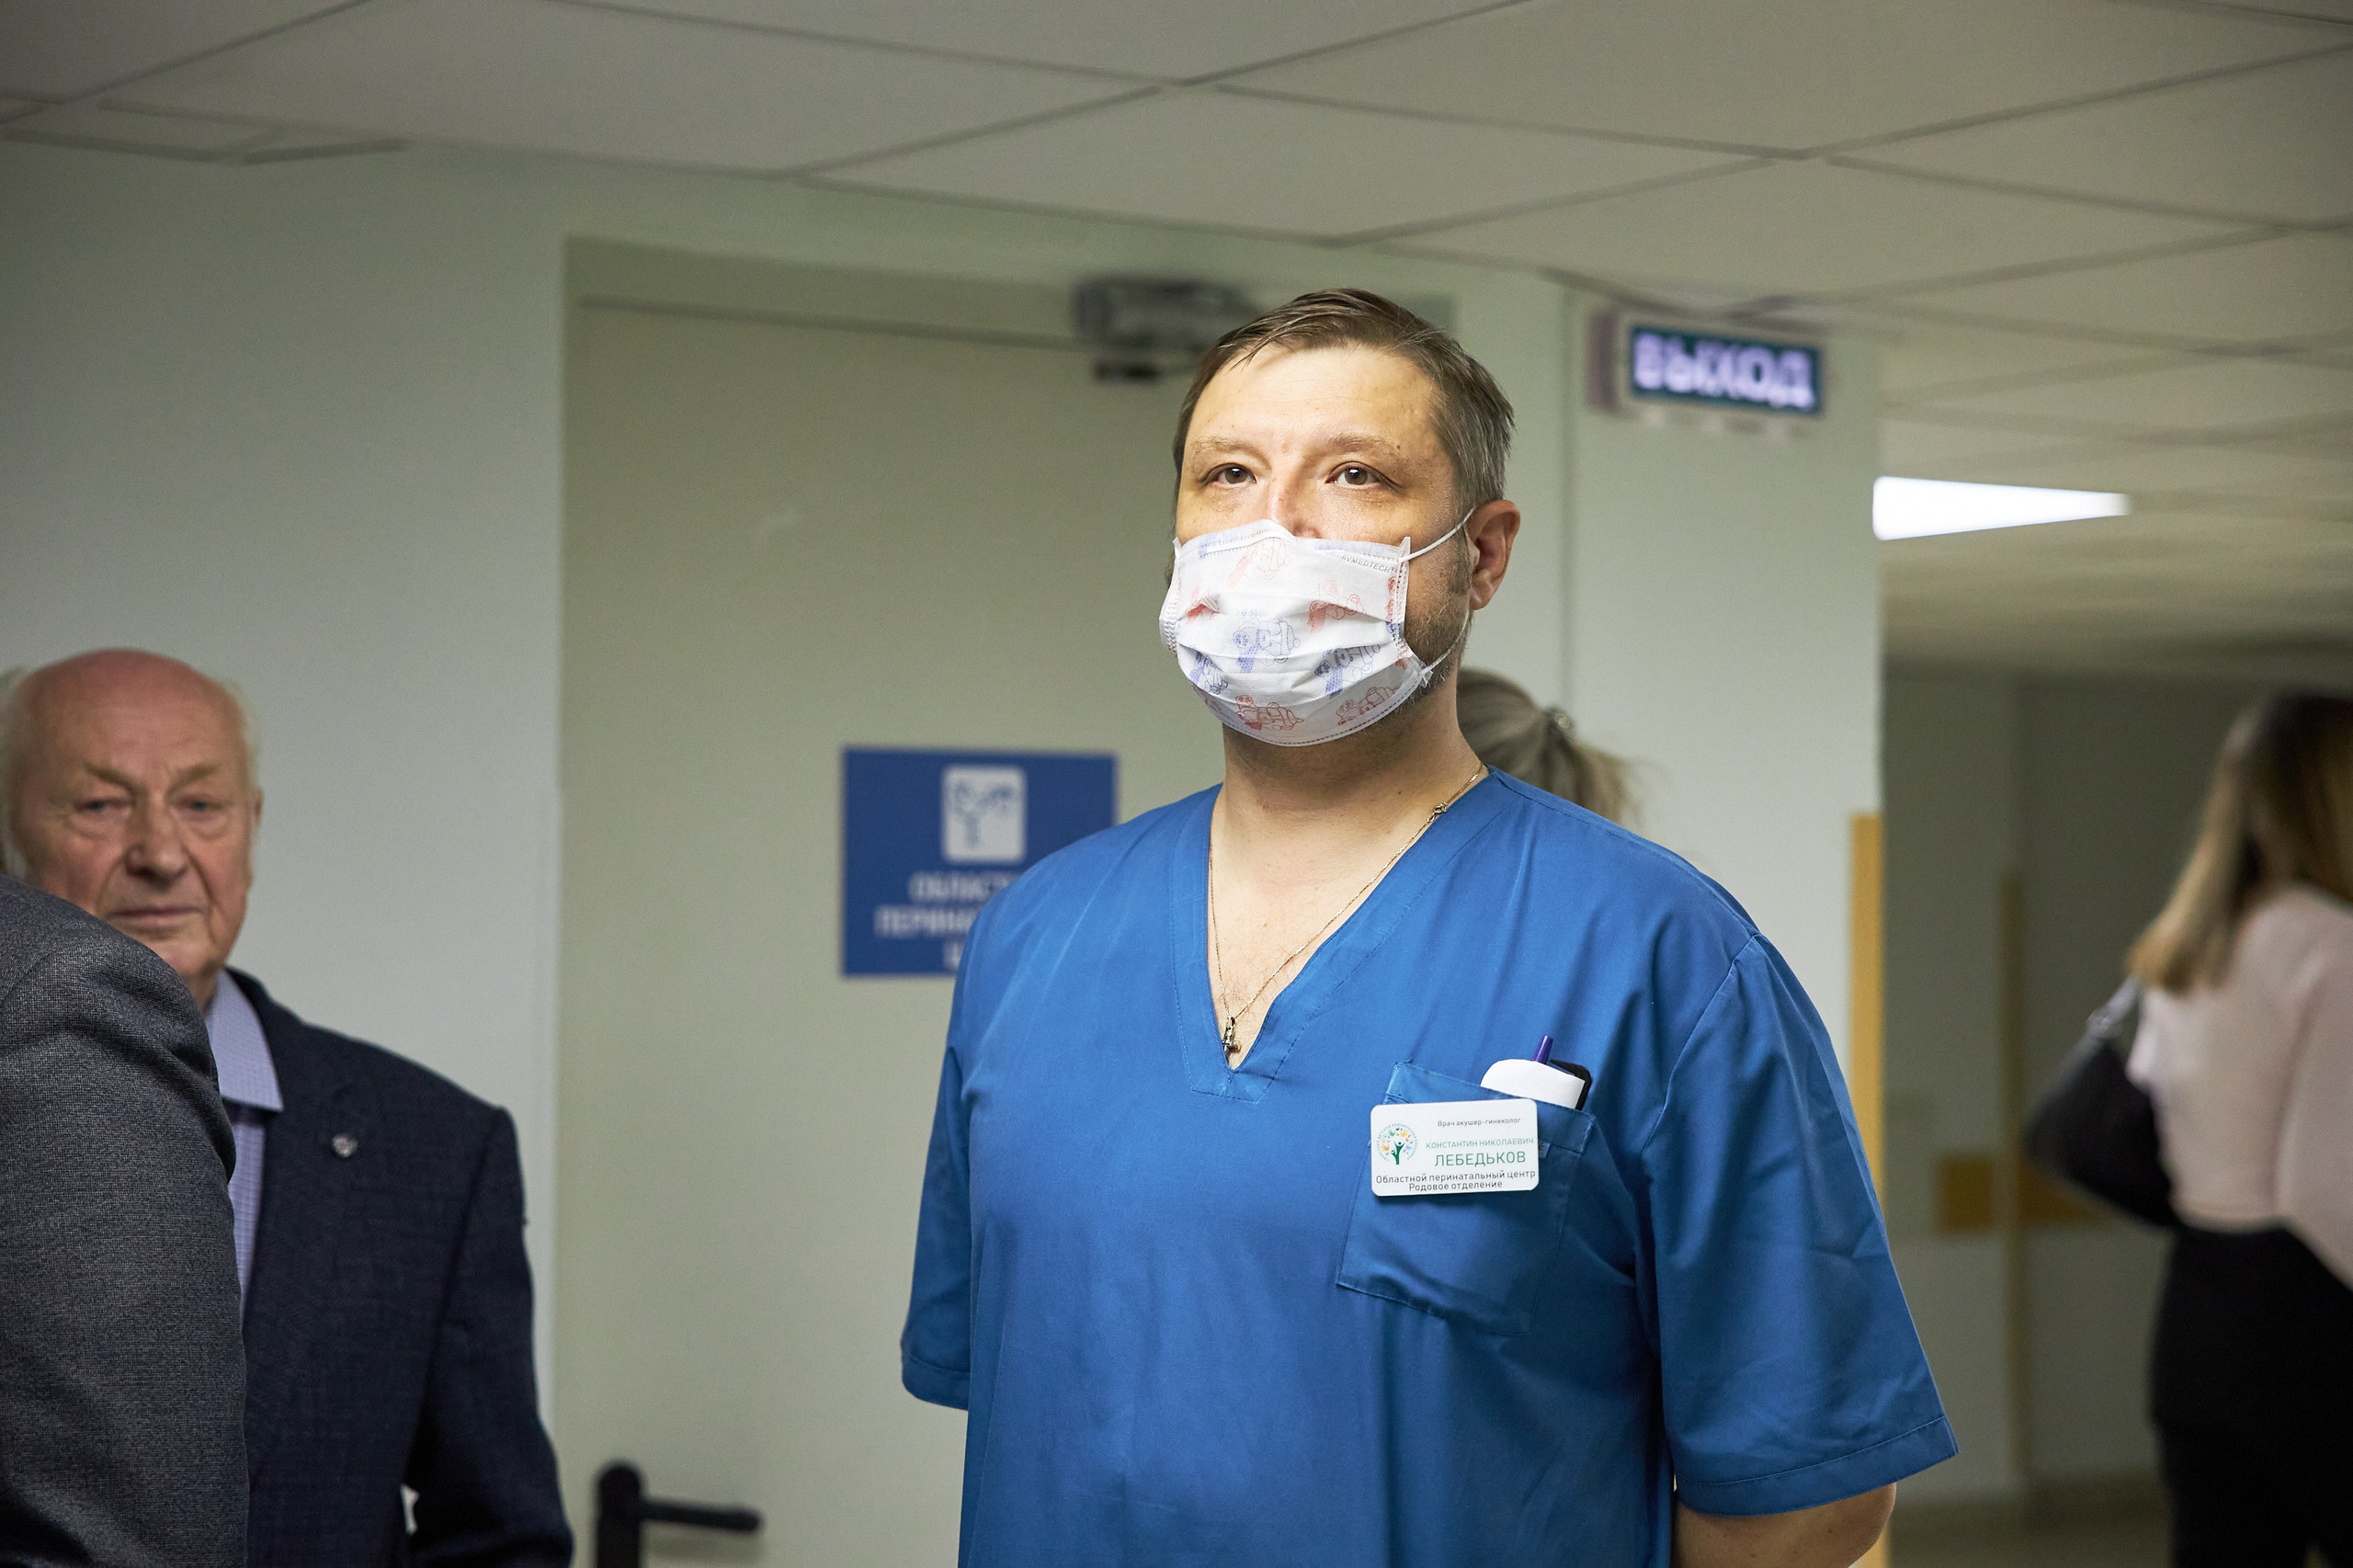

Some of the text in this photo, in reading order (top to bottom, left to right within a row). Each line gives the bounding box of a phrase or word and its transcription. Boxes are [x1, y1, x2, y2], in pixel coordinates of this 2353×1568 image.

[1636, 333, 1813, 407] ВЫХОД
[1325, 551, 1391, 574] DAVMEDTECH
[1437, 1118, 1521, 1128] Врач акушер-гинеколог
[1426, 1137, 1534, 1149] КОНСТАНТИН НИКОЛАЕВИЧ
[1434, 1151, 1526, 1166] ЛЕБЕДЬКОВ
[1376, 1170, 1536, 1184] Областной перинатальный центр
[1408, 1181, 1503, 1192] Родовое отделение
